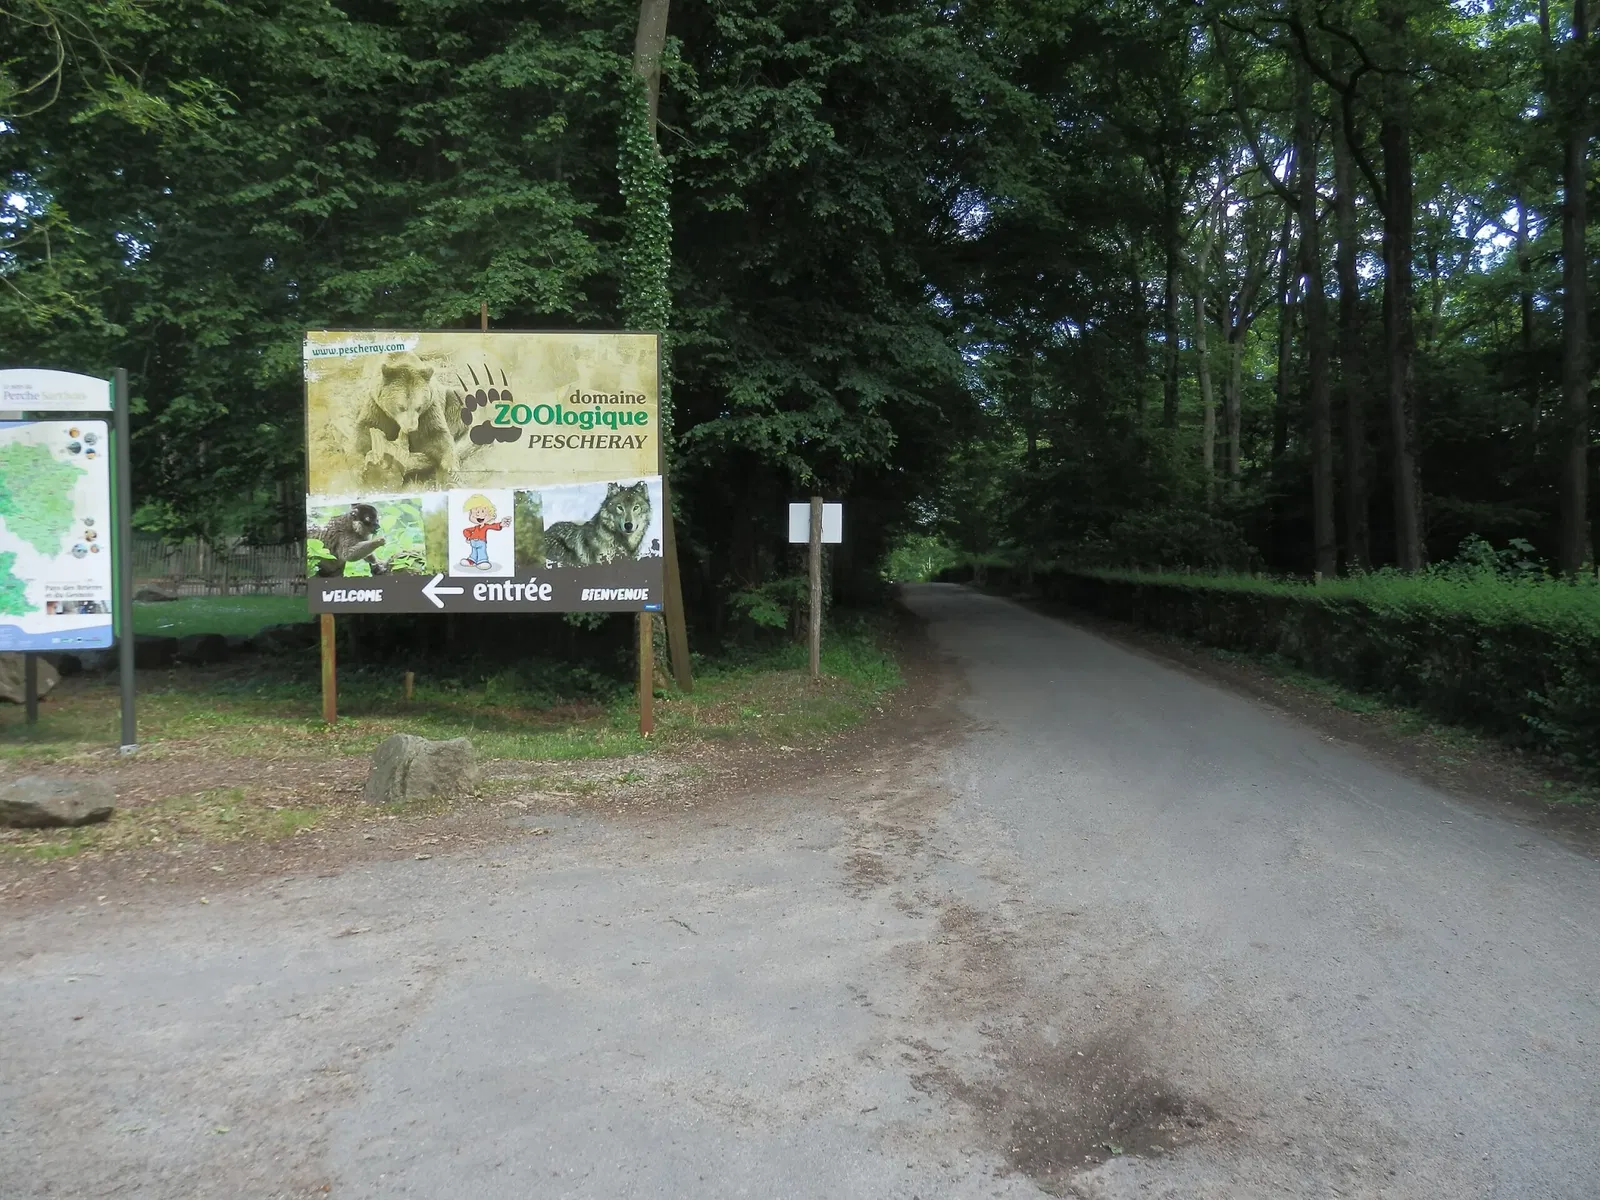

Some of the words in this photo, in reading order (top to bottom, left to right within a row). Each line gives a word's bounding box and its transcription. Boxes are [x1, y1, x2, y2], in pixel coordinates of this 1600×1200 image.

[312, 342, 405, 356] www.pescheray.com
[569, 389, 646, 405] domaine
[494, 404, 648, 430] ZOOlogique
[528, 434, 648, 449] PESCHERAY
[322, 589, 383, 603] WELCOME
[473, 577, 553, 602] entrée
[581, 588, 649, 601] BIENVENUE
